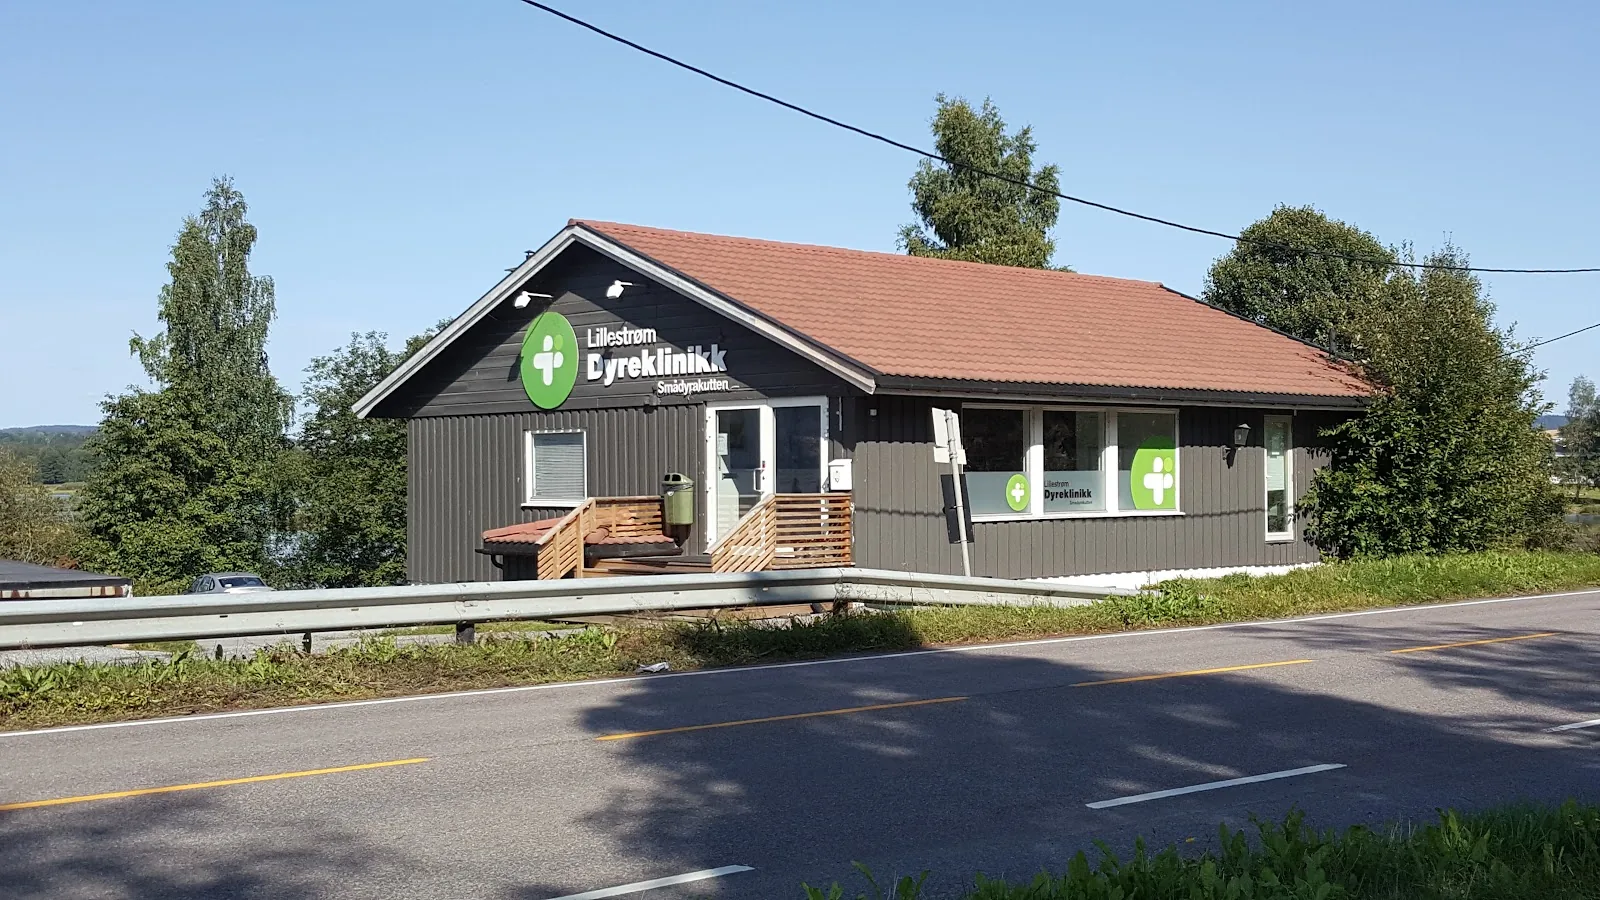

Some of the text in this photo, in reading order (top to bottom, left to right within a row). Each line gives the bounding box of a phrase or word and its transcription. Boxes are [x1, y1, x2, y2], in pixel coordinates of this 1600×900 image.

[587, 327, 657, 347] Lillestrøm
[587, 344, 728, 386] Dyreklinikk
[1044, 489, 1092, 501] Dyreklinikk
